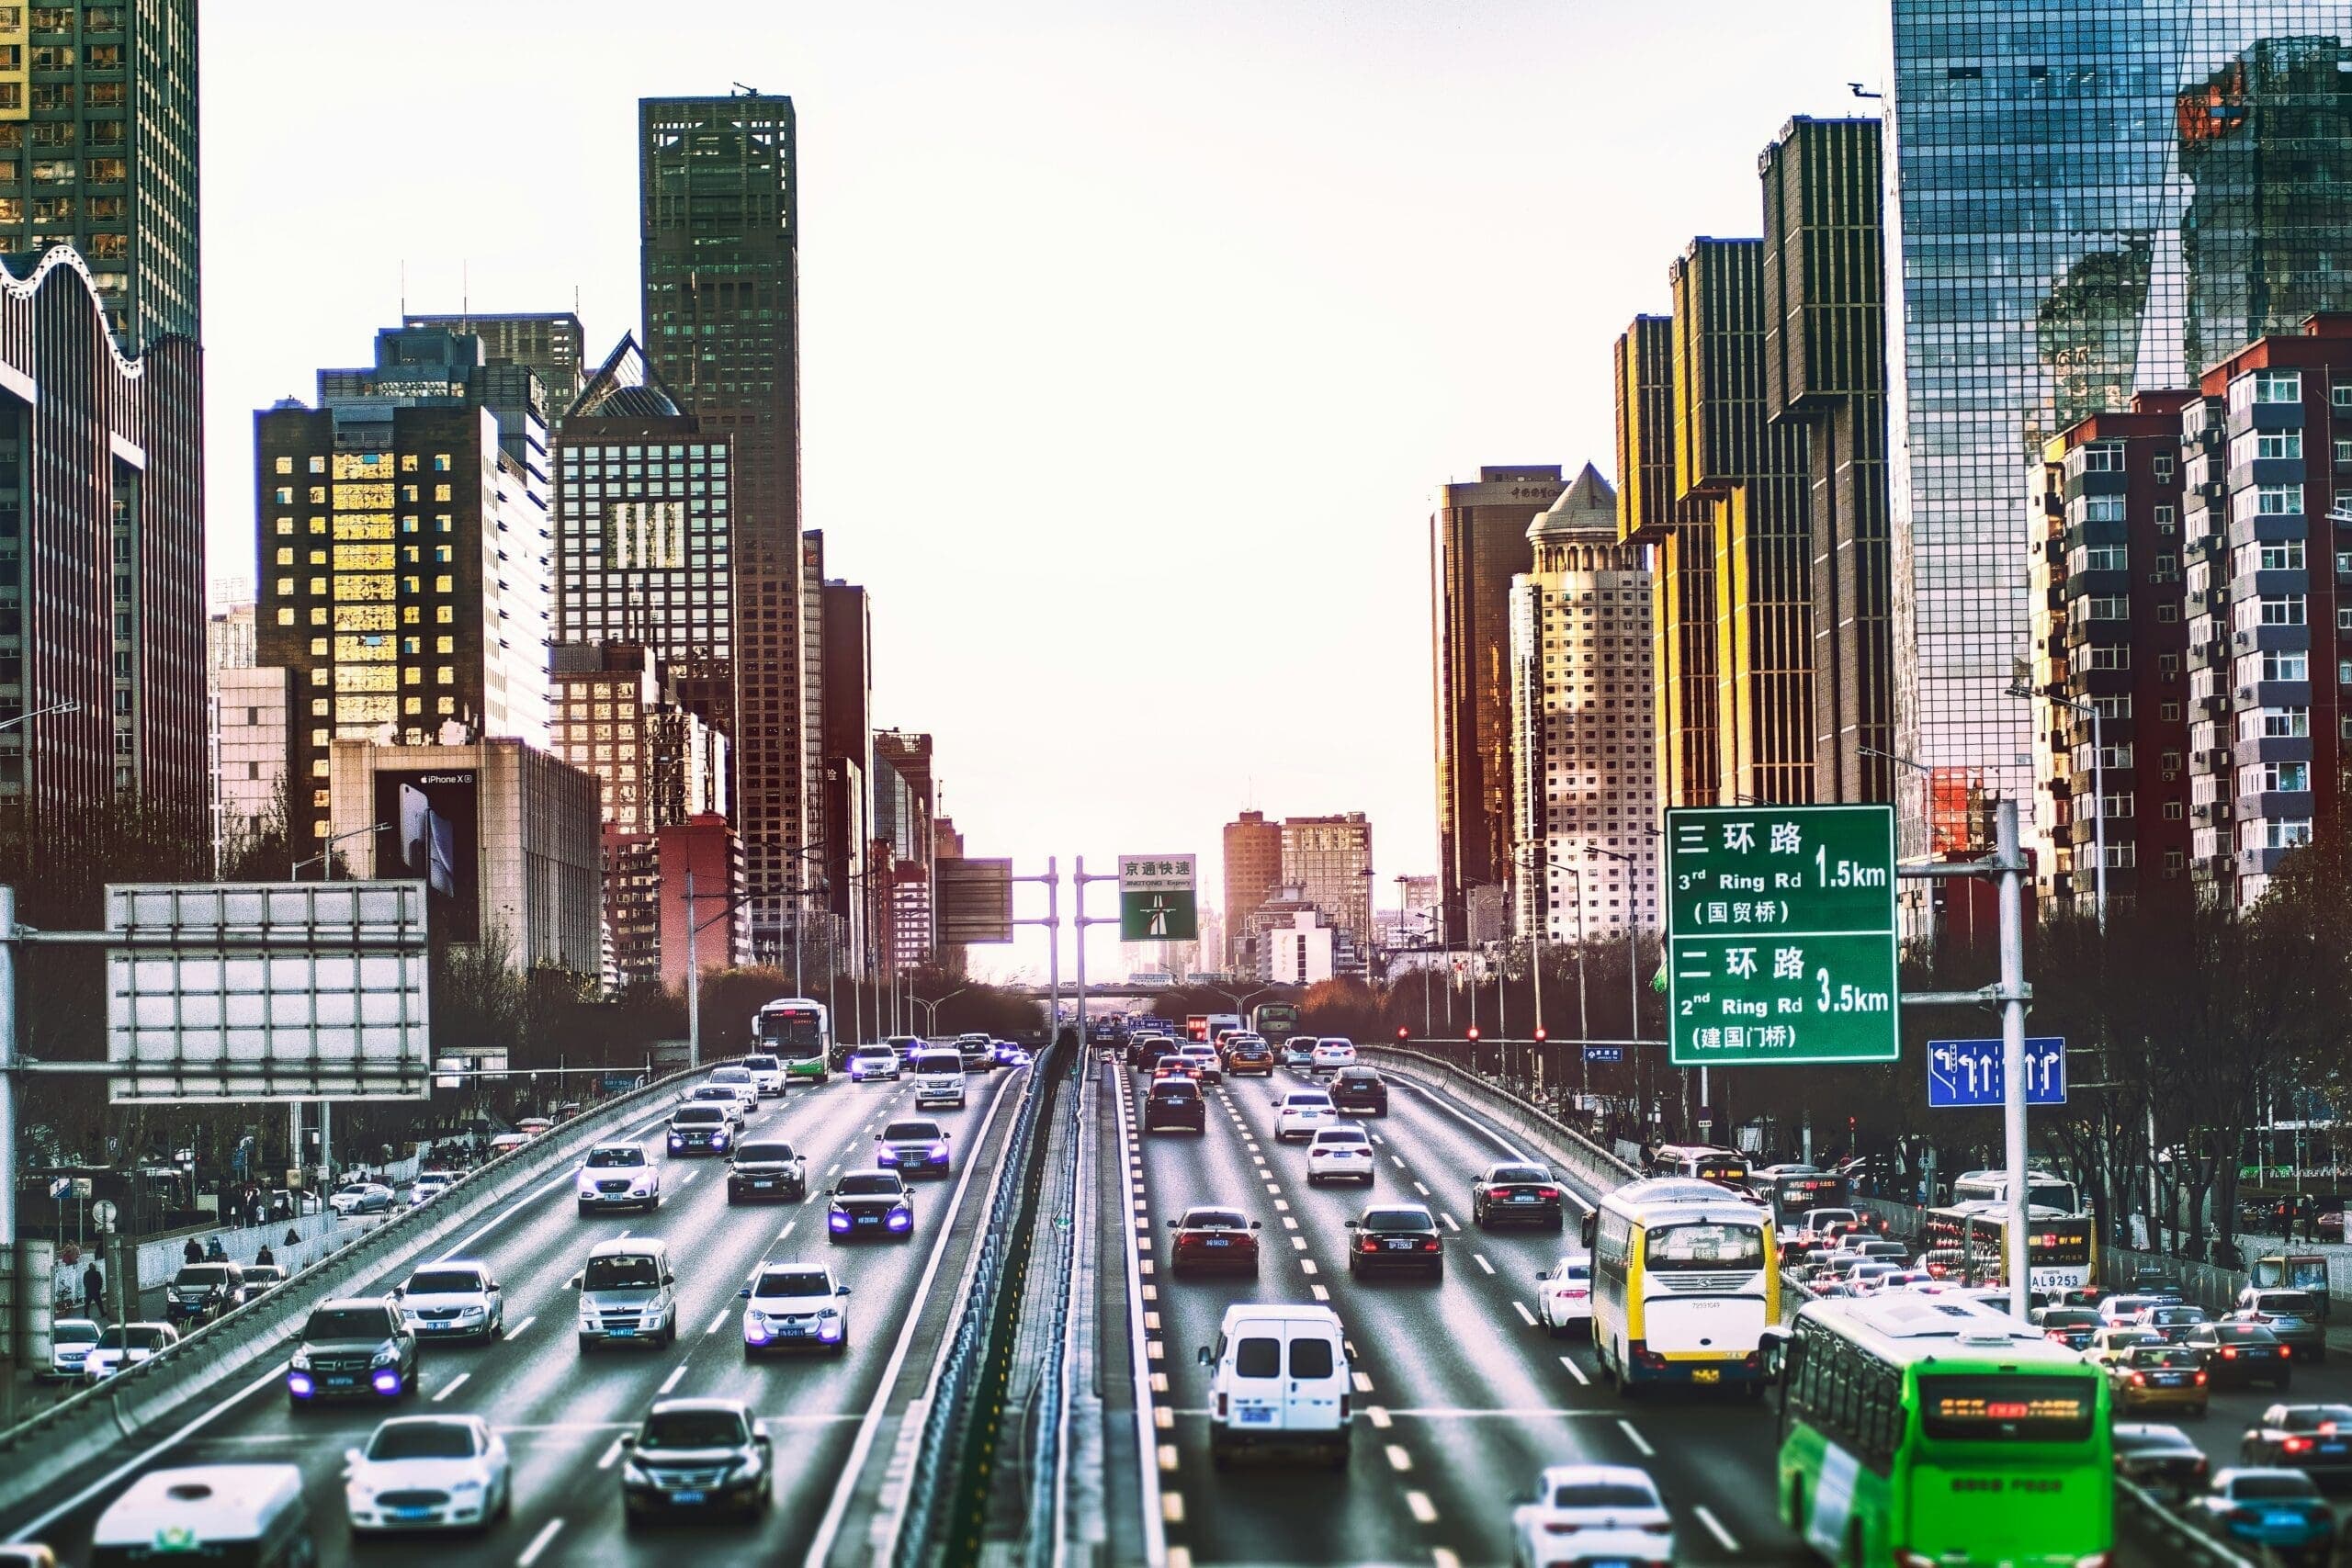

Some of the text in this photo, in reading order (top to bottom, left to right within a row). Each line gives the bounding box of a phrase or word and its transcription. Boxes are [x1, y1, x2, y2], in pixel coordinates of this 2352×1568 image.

[428, 775, 457, 784] iPhone
[1677, 821, 1803, 855] 三环路
[1125, 861, 1190, 876] 京通快速
[1815, 843, 1886, 888] 1.5km
[1679, 869, 1802, 892] 3rd Ring Rd
[1694, 901, 1789, 925] (国贸桥)
[1679, 946, 1805, 980] 二环路
[1816, 967, 1889, 1012] 3.5km
[1680, 993, 1803, 1018] 2nd Ring Rd
[1692, 1025, 1796, 1050] (建国门桥)
